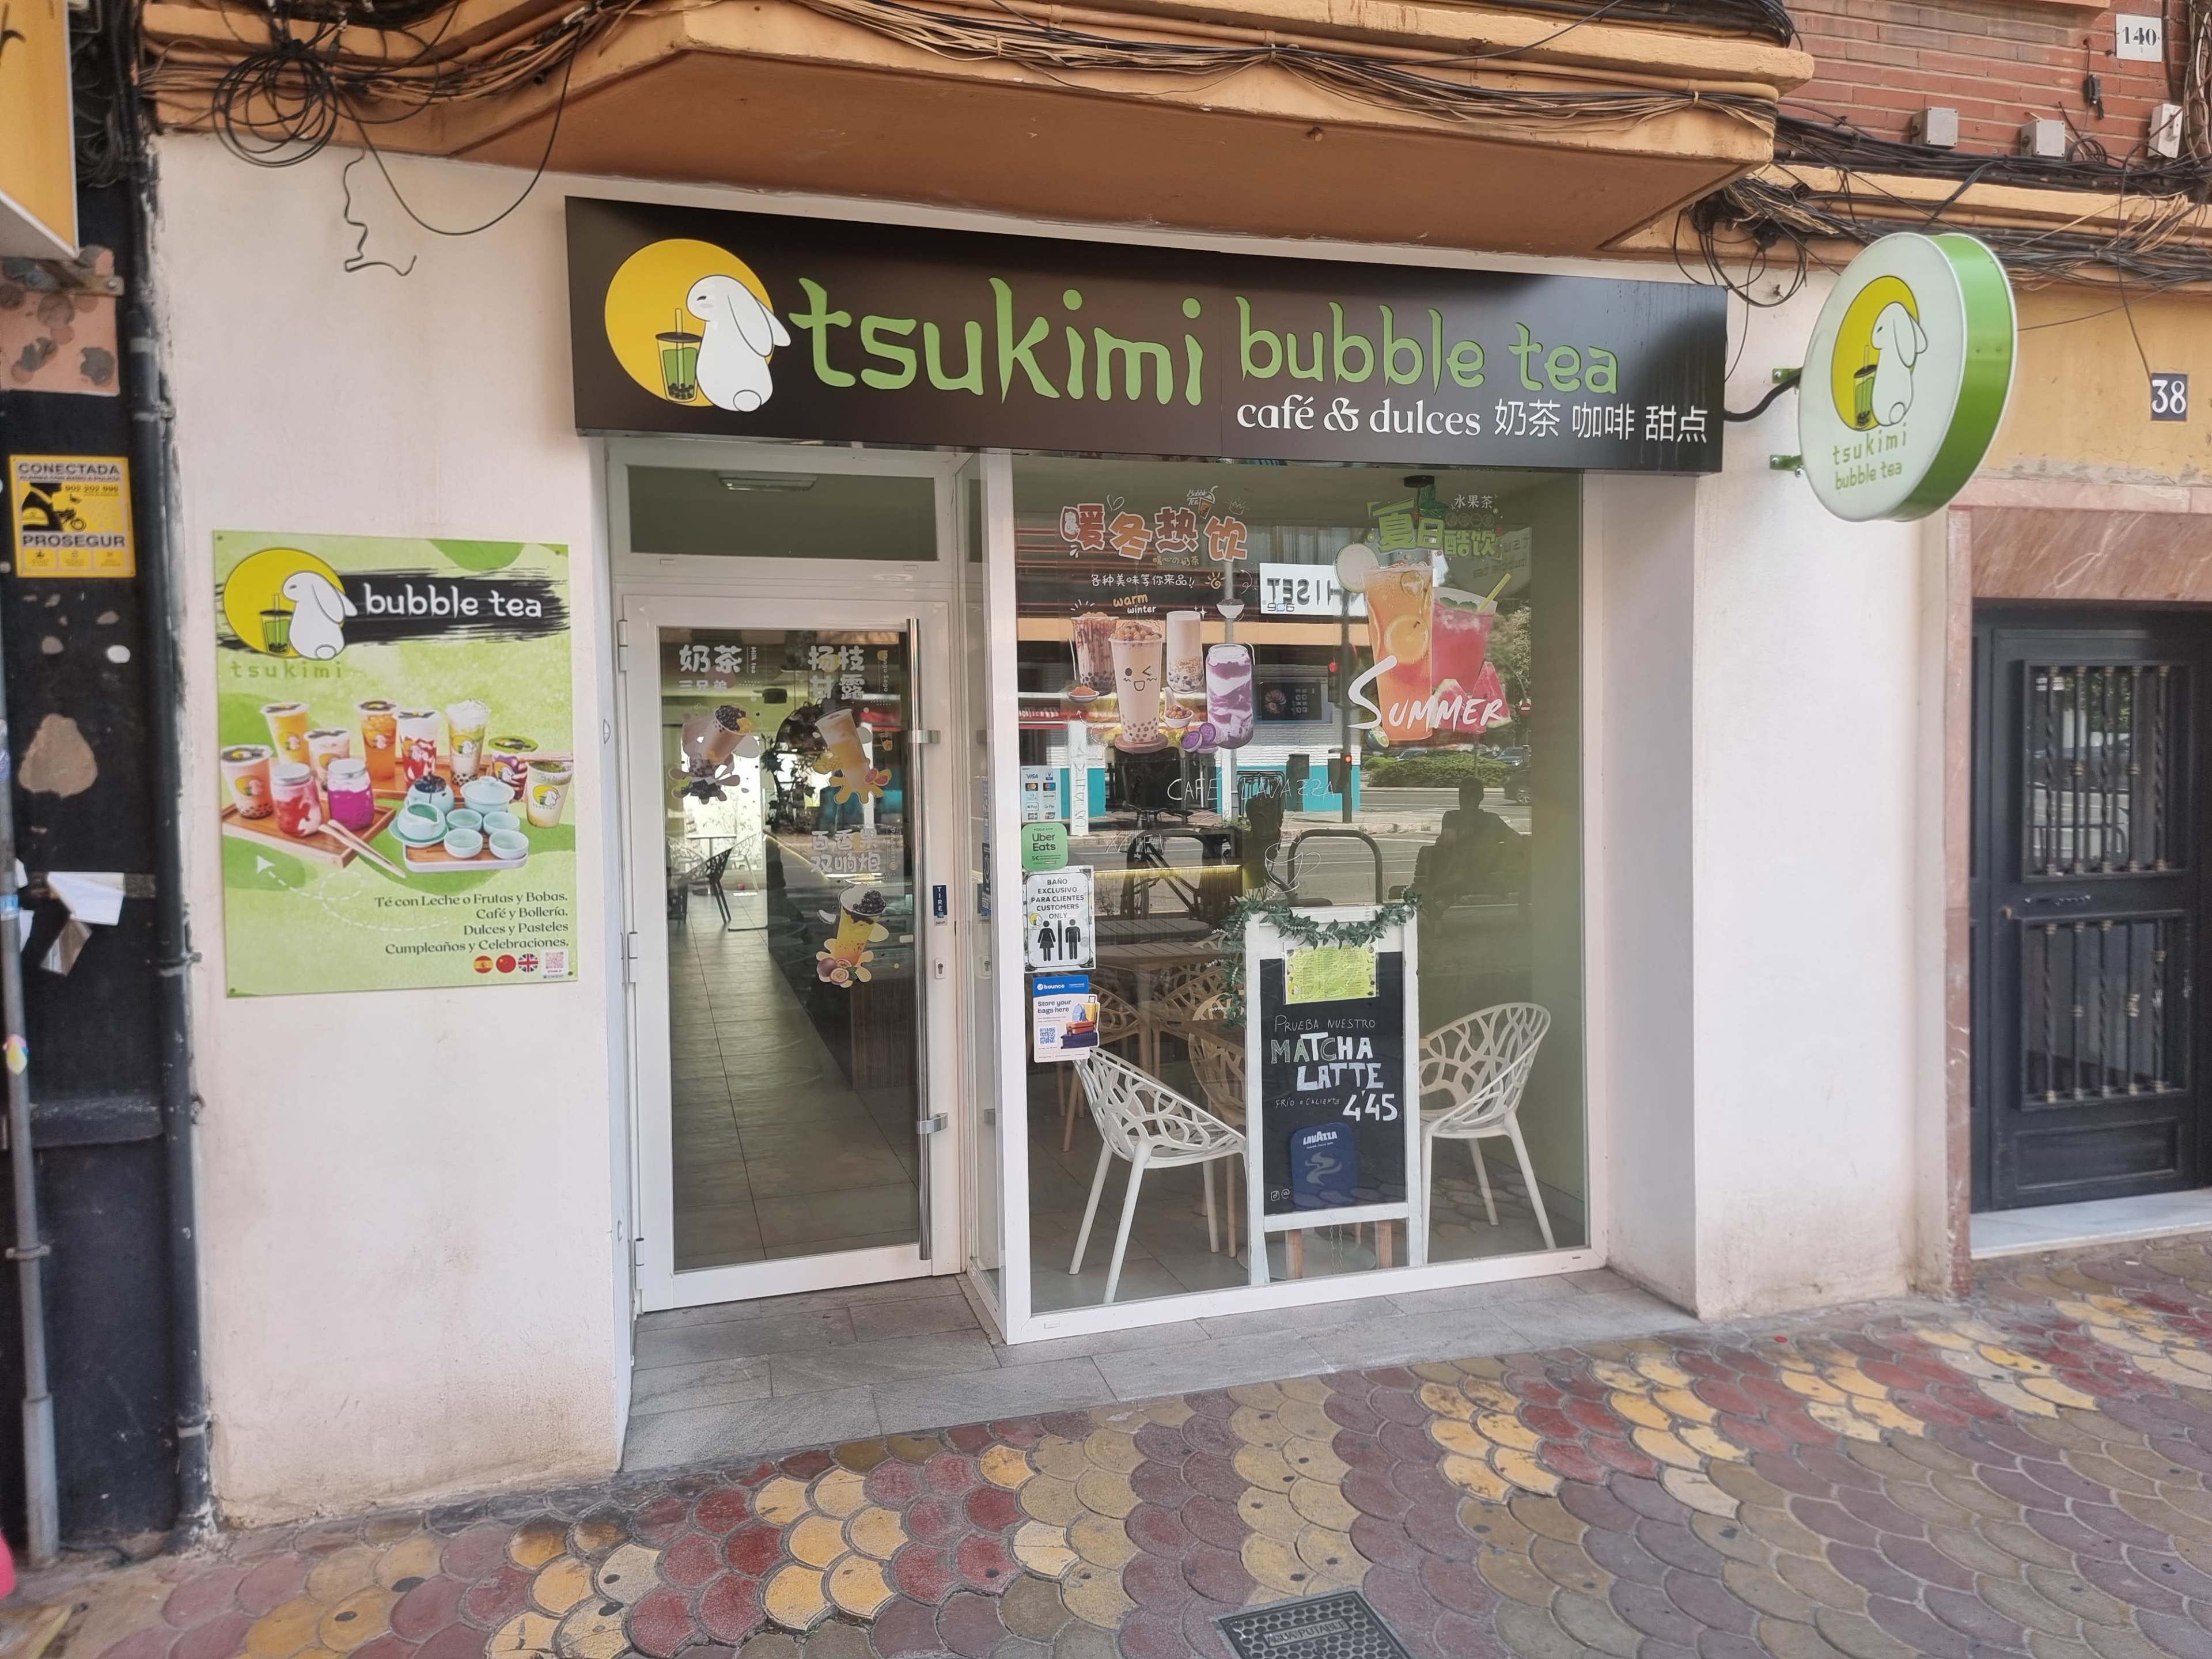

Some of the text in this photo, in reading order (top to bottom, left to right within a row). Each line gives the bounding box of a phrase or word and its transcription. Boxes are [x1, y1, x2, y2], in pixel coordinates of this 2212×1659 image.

[2122, 26, 2157, 46] 140
[789, 277, 1204, 406] tsukimi
[1235, 296, 1619, 396] bubble tea
[2152, 380, 2187, 414] 38
[1237, 395, 1481, 436] café & dulces
[1495, 398, 1708, 444] 奶茶 咖啡 甜点
[1832, 422, 1906, 465] tsukimi
[18, 463, 120, 475] CONECTADA
[1835, 461, 1903, 490] bubble tea
[1454, 494, 1493, 509] 水果茶
[1060, 503, 1248, 562] 暖冬热饮
[1369, 498, 1498, 556] 夏日酷饮
[22, 534, 125, 547] PROSEGUR
[363, 582, 542, 619] bubble tea
[1113, 594, 1148, 608] warm
[1127, 605, 1157, 615] winter
[231, 660, 342, 678] tsukimi
[679, 644, 743, 673] 奶茶
[808, 645, 865, 671] 杨枝
[810, 674, 865, 700] 甘露
[1347, 655, 1505, 732] SUMMER
[1241, 778, 1335, 800] LAVAZZA
[812, 828, 878, 851] 百香果
[1032, 833, 1055, 842] Uber
[1033, 843, 1056, 851] Eats
[1047, 877, 1067, 885] BAÑO
[374, 896, 392, 908] Té
[395, 897, 419, 907] con
[422, 895, 460, 906] Leche
[474, 893, 513, 904] Frutas
[516, 894, 524, 905] y
[526, 891, 567, 903] Bobas.
[476, 907, 568, 920] Café y Bollería.
[464, 922, 569, 935] Dulces y Pasteles
[385, 938, 569, 956] Cumpleaños y Celebraciones.
[1274, 1015, 1376, 1033] PRUEBA NUESTRO
[1271, 1032, 1373, 1064] MATCHA
[1297, 1062, 1384, 1090] LATTE
[1303, 1131, 1338, 1145] LAVAZZA
